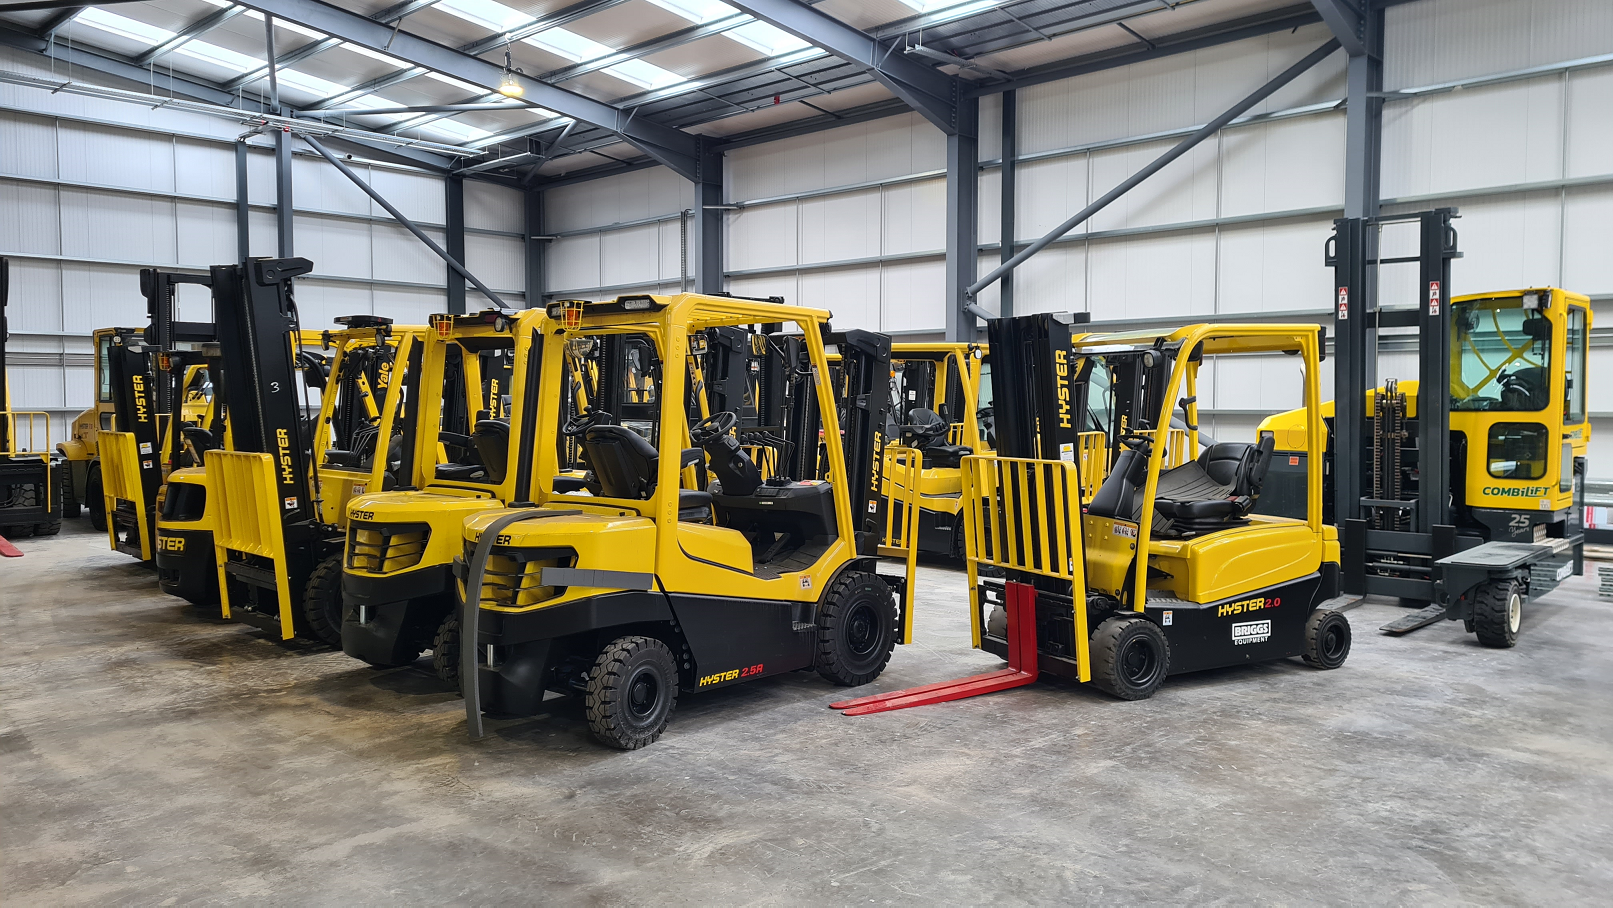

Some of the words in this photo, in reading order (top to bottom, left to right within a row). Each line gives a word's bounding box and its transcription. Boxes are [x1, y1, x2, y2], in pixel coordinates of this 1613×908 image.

[377, 362, 389, 388] Yale
[270, 381, 280, 393] 3
[1055, 349, 1072, 428] HYSTER
[132, 375, 149, 422] HYSTER
[276, 428, 295, 484] HYSTER
[871, 431, 882, 492] HYSTER
[1508, 514, 1531, 527] 25
[1218, 597, 1265, 617] HYSTER
[1265, 597, 1281, 608] 2.0
[1234, 623, 1269, 637] BRIGGS
[1234, 636, 1269, 645] EQUIPMENT
[699, 669, 740, 687] HYSTER
